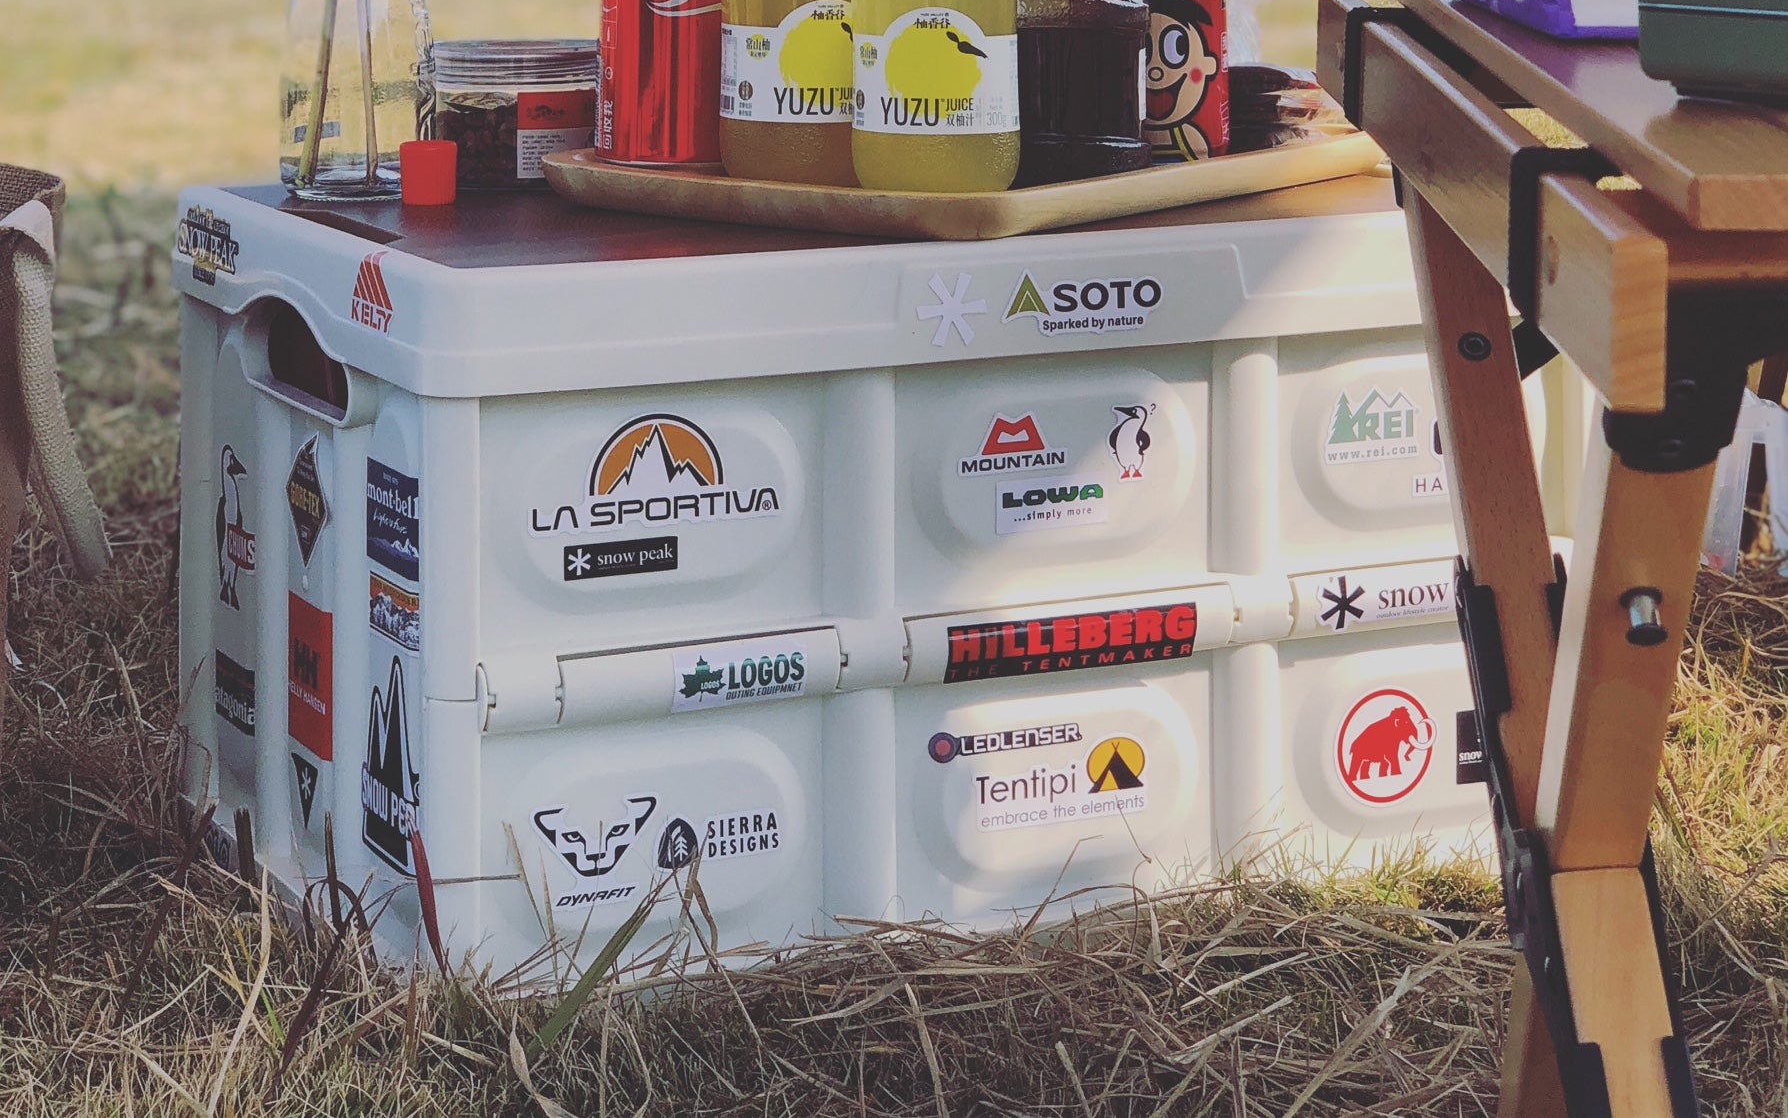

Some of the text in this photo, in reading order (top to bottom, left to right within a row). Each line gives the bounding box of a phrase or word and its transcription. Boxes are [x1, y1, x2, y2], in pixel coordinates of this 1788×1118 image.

[913, 17, 951, 30] 柚香谷
[773, 87, 834, 116] YUZU
[839, 86, 853, 101] JUI
[880, 96, 939, 127] YUZU
[945, 97, 974, 112] JUICE
[945, 113, 974, 127] 双柚汁
[1053, 279, 1162, 313] SOTO
[351, 298, 393, 334] KELTY
[1042, 315, 1144, 332] Sparked by nature
[1357, 409, 1415, 440] REI
[961, 451, 1065, 474] MOUNTAIN
[1327, 444, 1418, 462] www.rei.com
[532, 487, 779, 532] LA SPORTIVA
[1002, 483, 1104, 509] LOWA
[1067, 506, 1092, 517] more
[228, 529, 255, 564] CHUMS
[597, 552, 636, 566] snow
[639, 543, 673, 566] peak
[1378, 582, 1449, 610] snow
[728, 651, 805, 690] LOGOS
[950, 643, 1193, 680] THE TENTMAKER
[215, 686, 255, 726] atagonia
[726, 689, 756, 701] OUTING
[960, 724, 1079, 755] LEDLENSER
[362, 767, 389, 823] SNOW
[976, 764, 1077, 804] Tentipi
[981, 795, 1145, 828] embrace the elements
[707, 812, 779, 858] SIERRA DESIGNS
[556, 886, 636, 907] DYNAFIT
